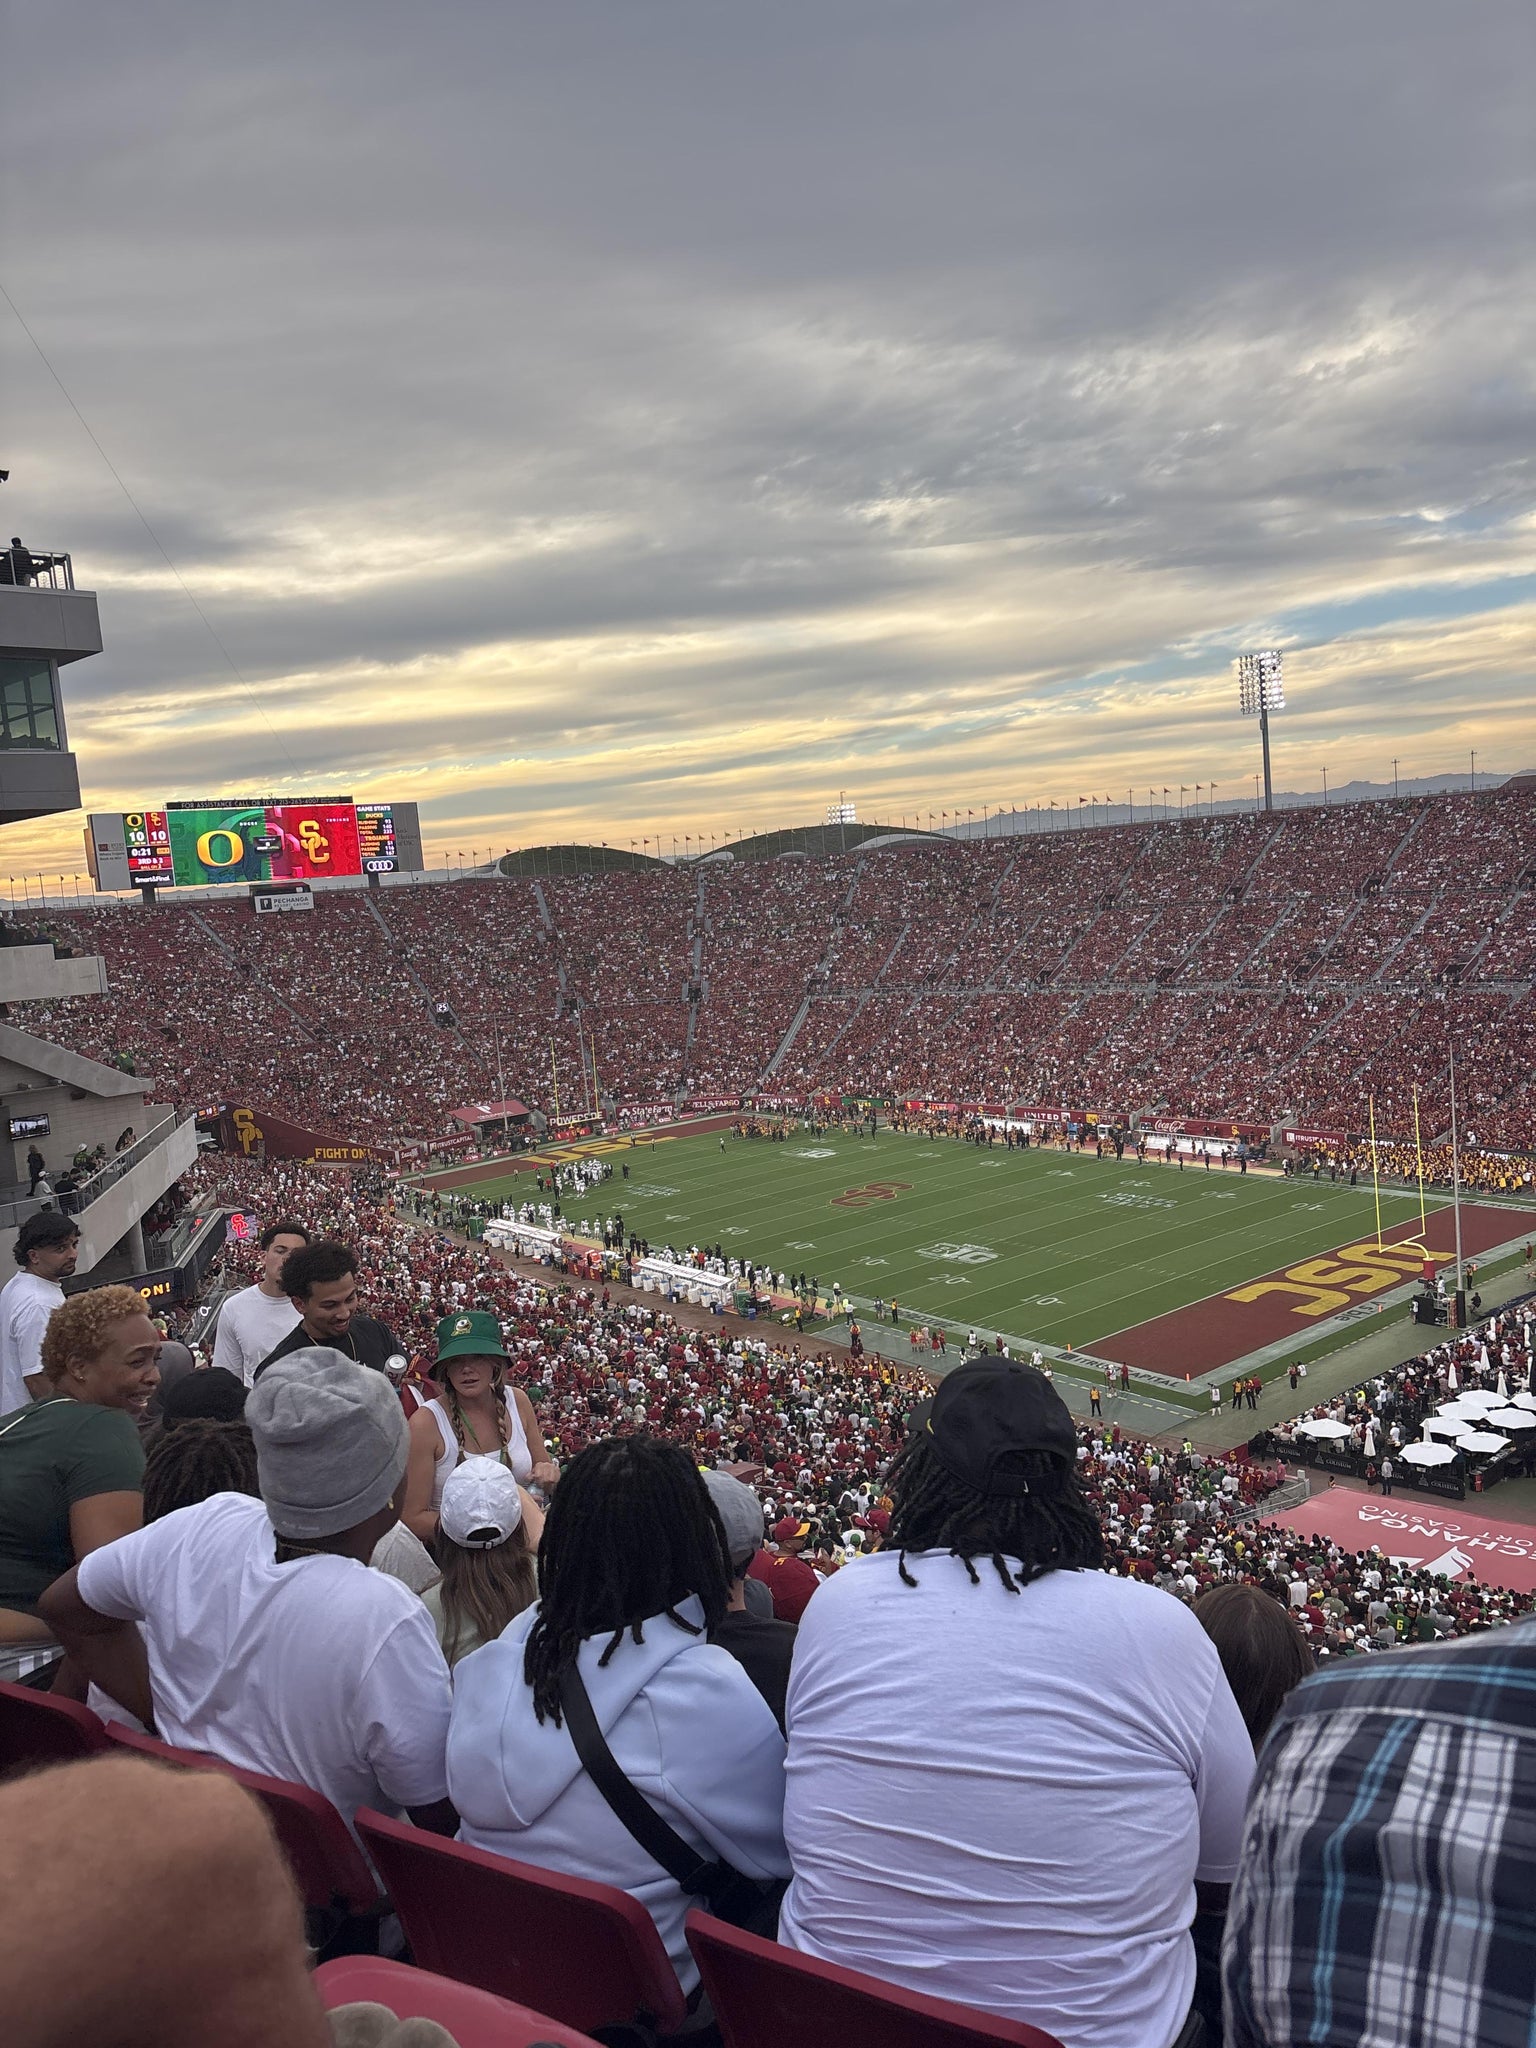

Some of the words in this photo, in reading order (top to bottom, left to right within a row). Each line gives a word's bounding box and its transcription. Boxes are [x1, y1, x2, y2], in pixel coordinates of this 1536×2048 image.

[129, 832, 145, 842] 10
[151, 830, 166, 841] 10
[299, 820, 330, 864] SC
[131, 848, 152, 856] 0:21
[196, 830, 244, 867] O
[1024, 1111, 1059, 1121] UNITED
[232, 1109, 263, 1155] SC
[315, 1148, 349, 1159] FIGHT
[520, 1136, 678, 1165] USC
[231, 1213, 249, 1239] SC
[928, 1274, 966, 1285] 20
[1222, 1243, 1458, 1316] USC
[140, 1282, 171, 1298] ON!
[1020, 1294, 1058, 1306] 10
[1326, 1459, 1352, 1469] COLISEUM
[1431, 1481, 1459, 1491] COLISEUM
[1362, 1504, 1462, 1532] CASINO
[1396, 1620, 1404, 1630] 6
